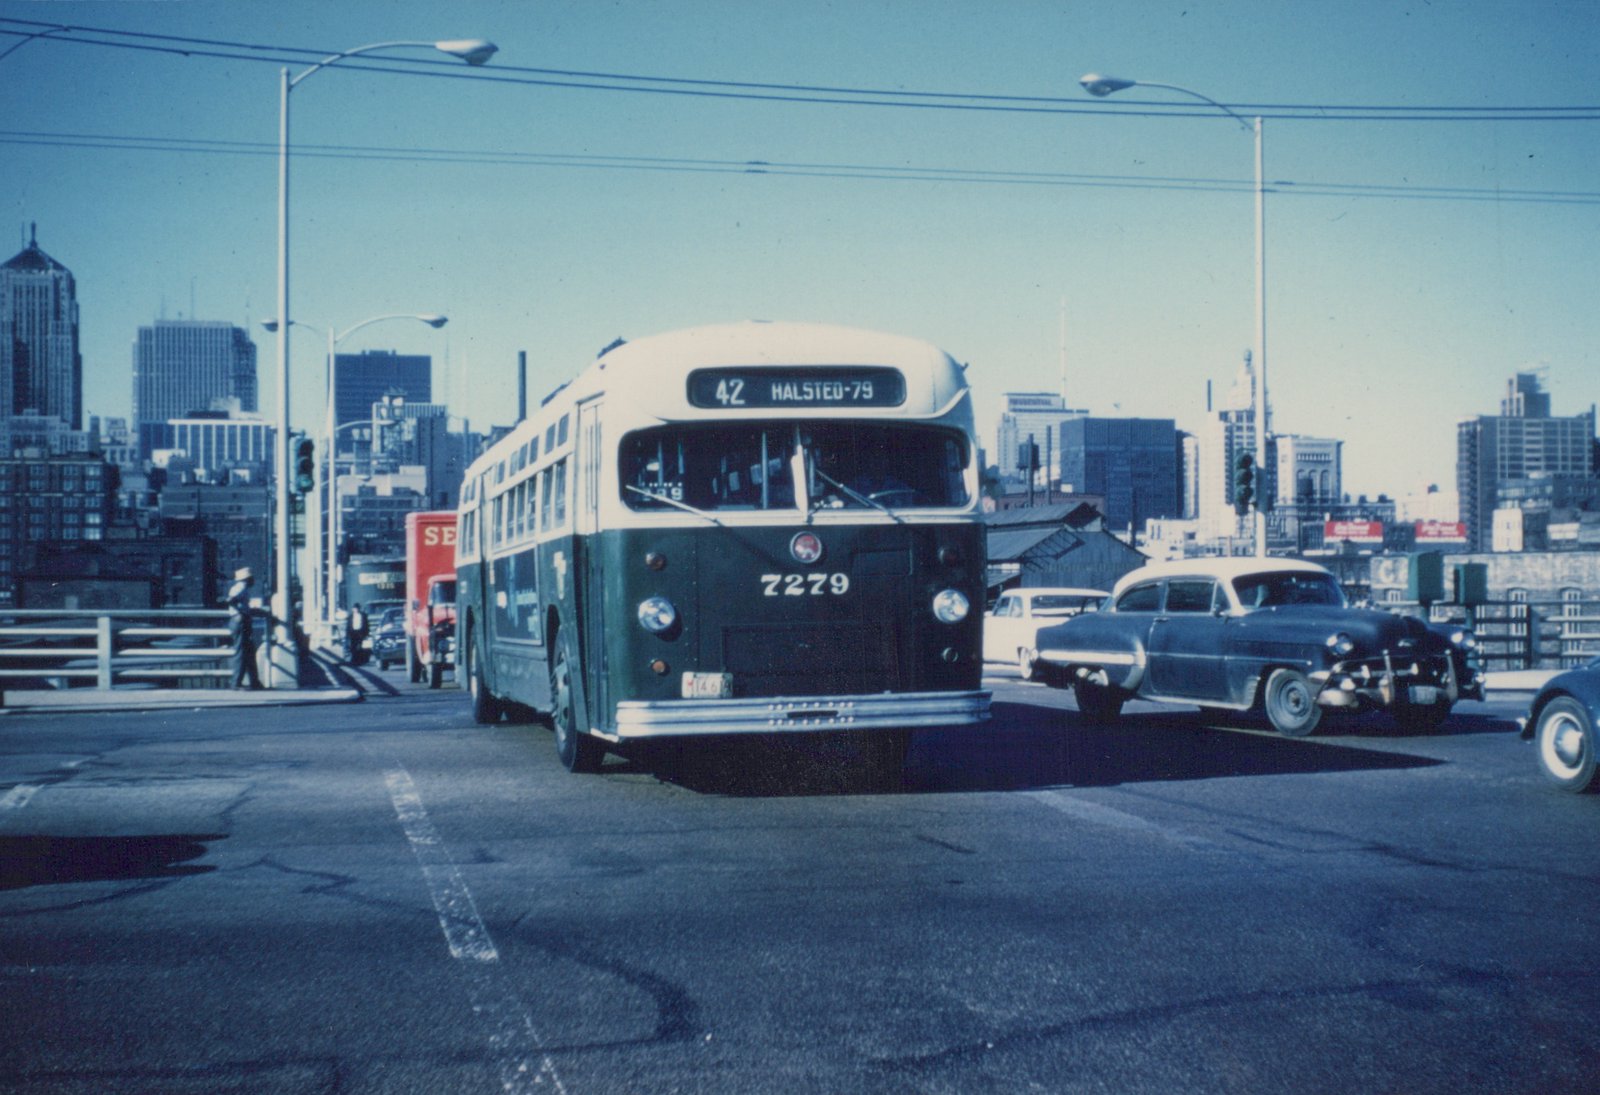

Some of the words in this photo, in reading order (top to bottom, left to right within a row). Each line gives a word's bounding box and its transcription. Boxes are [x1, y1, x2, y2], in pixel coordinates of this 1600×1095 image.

[715, 378, 746, 405] 42
[771, 380, 875, 401] HALSTED-79
[760, 572, 850, 597] 7279
